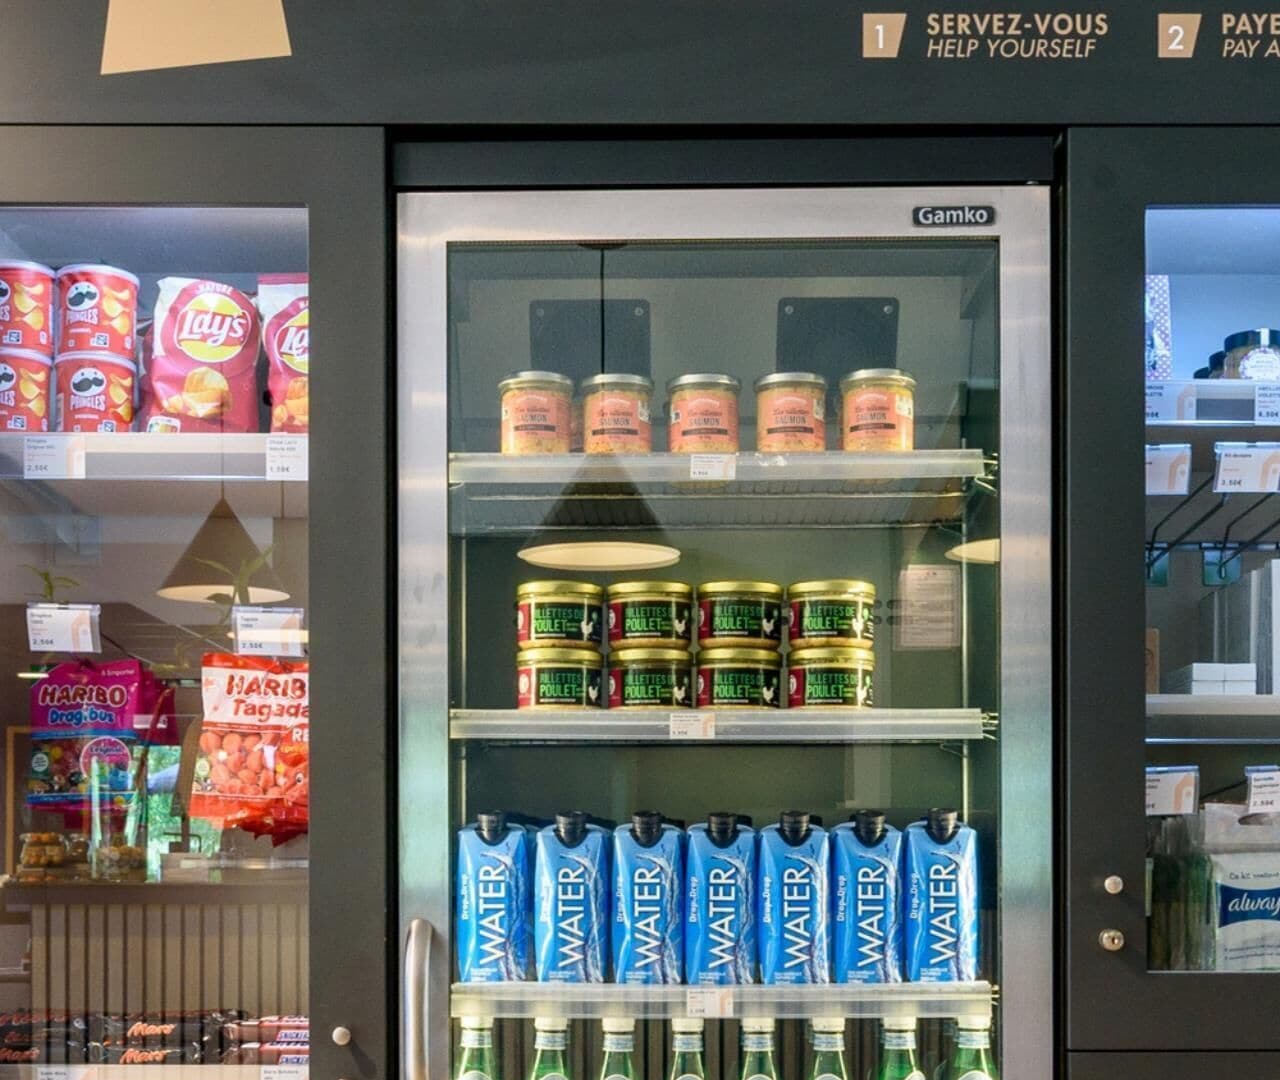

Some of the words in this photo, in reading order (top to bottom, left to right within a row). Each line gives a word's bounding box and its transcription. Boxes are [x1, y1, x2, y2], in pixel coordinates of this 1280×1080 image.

[927, 13, 1109, 37] SERVEZ-VOUS
[873, 24, 886, 50] 1
[1166, 24, 1185, 50] 2
[927, 39, 979, 58] HELP
[982, 38, 1097, 58] YOURSELF
[1222, 39, 1260, 58] PAY
[917, 205, 989, 226] Gamko
[66, 307, 99, 325] PRINGLES
[181, 309, 246, 346] Lay's
[70, 394, 107, 413] PRINGLES
[533, 619, 568, 633] POULET
[624, 618, 662, 632] POULET
[713, 616, 749, 630] POULET
[803, 616, 838, 630] POULET
[38, 683, 129, 707] HARIBO
[539, 684, 576, 698] POULET
[624, 685, 662, 699] POULET
[713, 684, 749, 698] POULET
[807, 684, 844, 698] POULET
[478, 863, 506, 965] WATER
[557, 866, 586, 968] WATER
[633, 866, 662, 968] WATER
[708, 867, 736, 969] WATER
[783, 866, 811, 968] WATER
[857, 866, 885, 967] WATER
[929, 863, 958, 965] WATER
[127, 1020, 178, 1039] Mars
